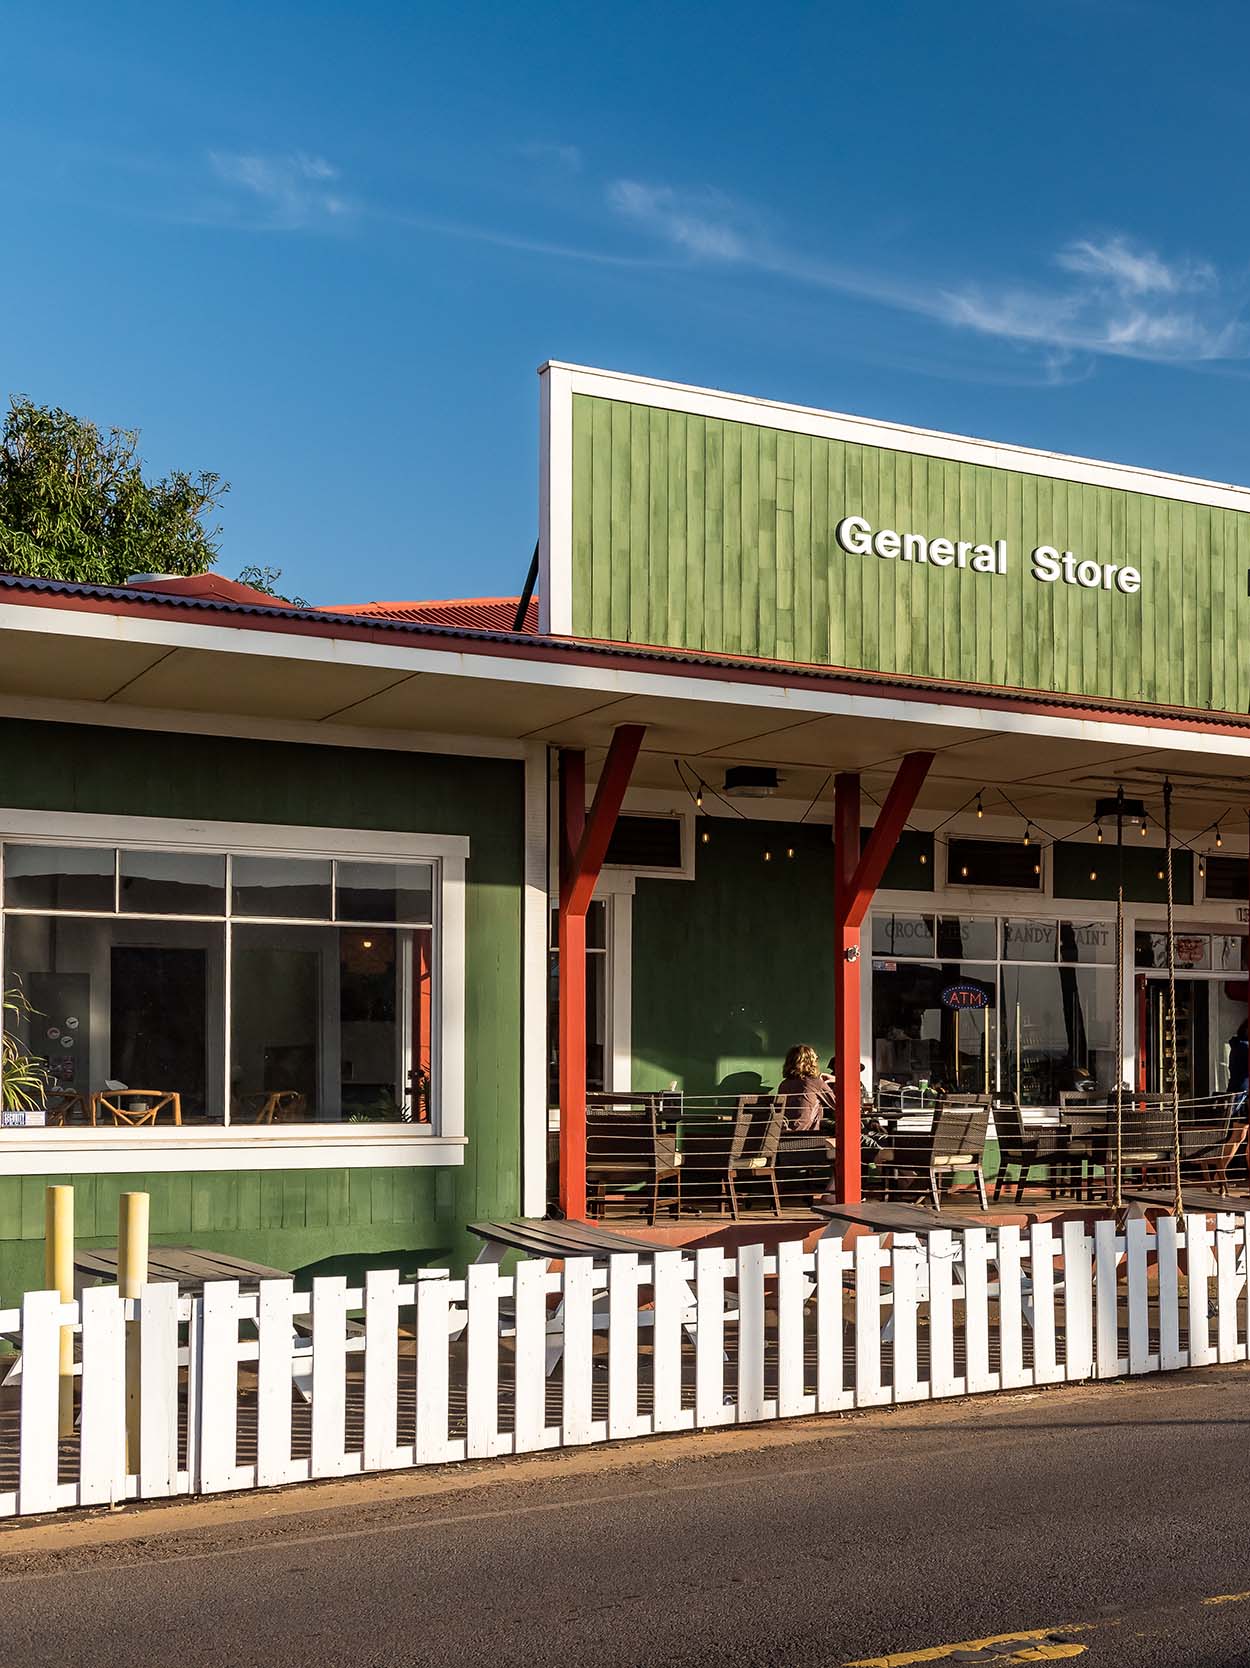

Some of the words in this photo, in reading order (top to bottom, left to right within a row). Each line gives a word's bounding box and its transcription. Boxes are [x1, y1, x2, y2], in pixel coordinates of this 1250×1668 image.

[836, 515, 1007, 575] General
[1032, 545, 1141, 594] Store
[884, 921, 970, 940] GROCIES
[1066, 930, 1109, 946] AINT
[949, 992, 982, 1006] ATM
